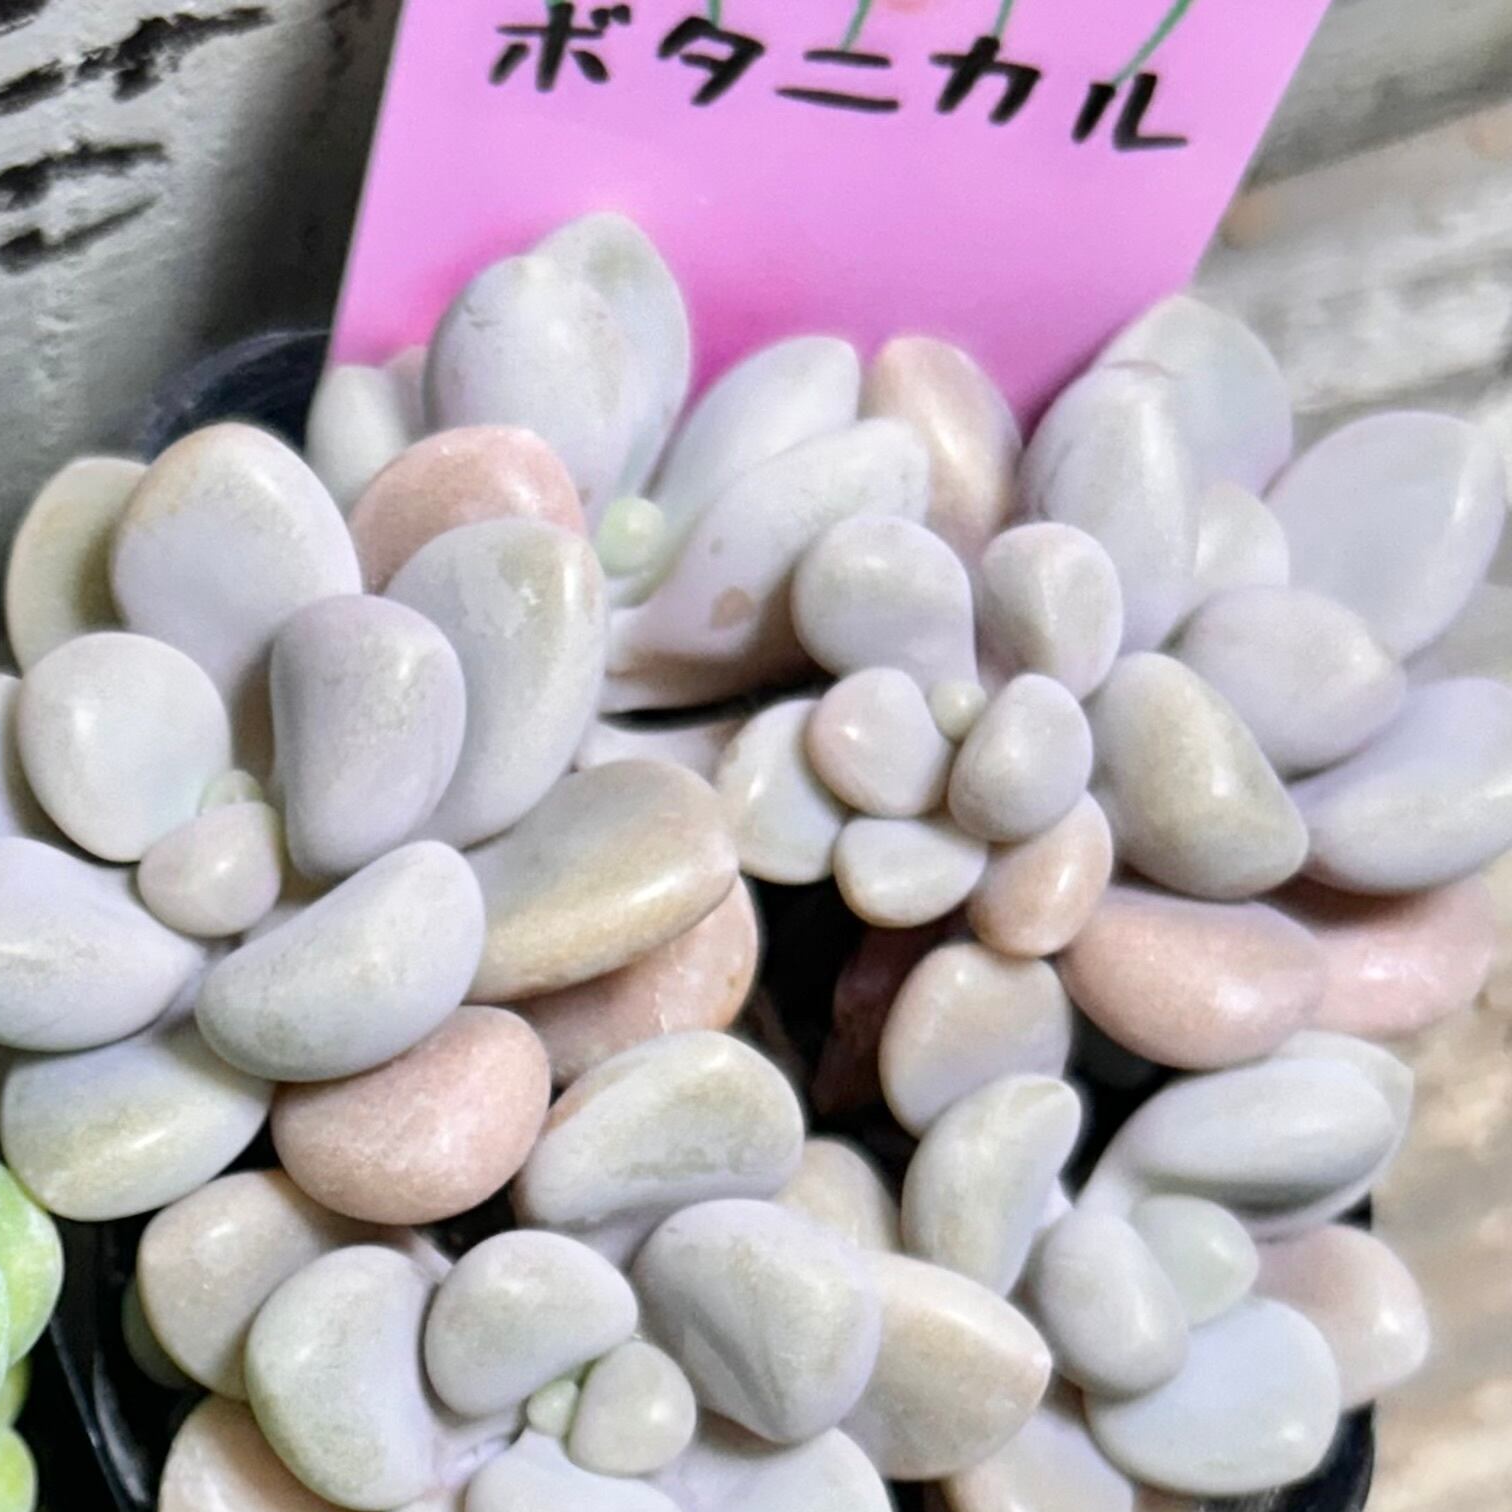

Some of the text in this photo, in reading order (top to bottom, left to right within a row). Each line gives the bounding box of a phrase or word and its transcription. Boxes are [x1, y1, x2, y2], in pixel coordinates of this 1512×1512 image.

[489, 1, 1188, 152] ボタニカル
